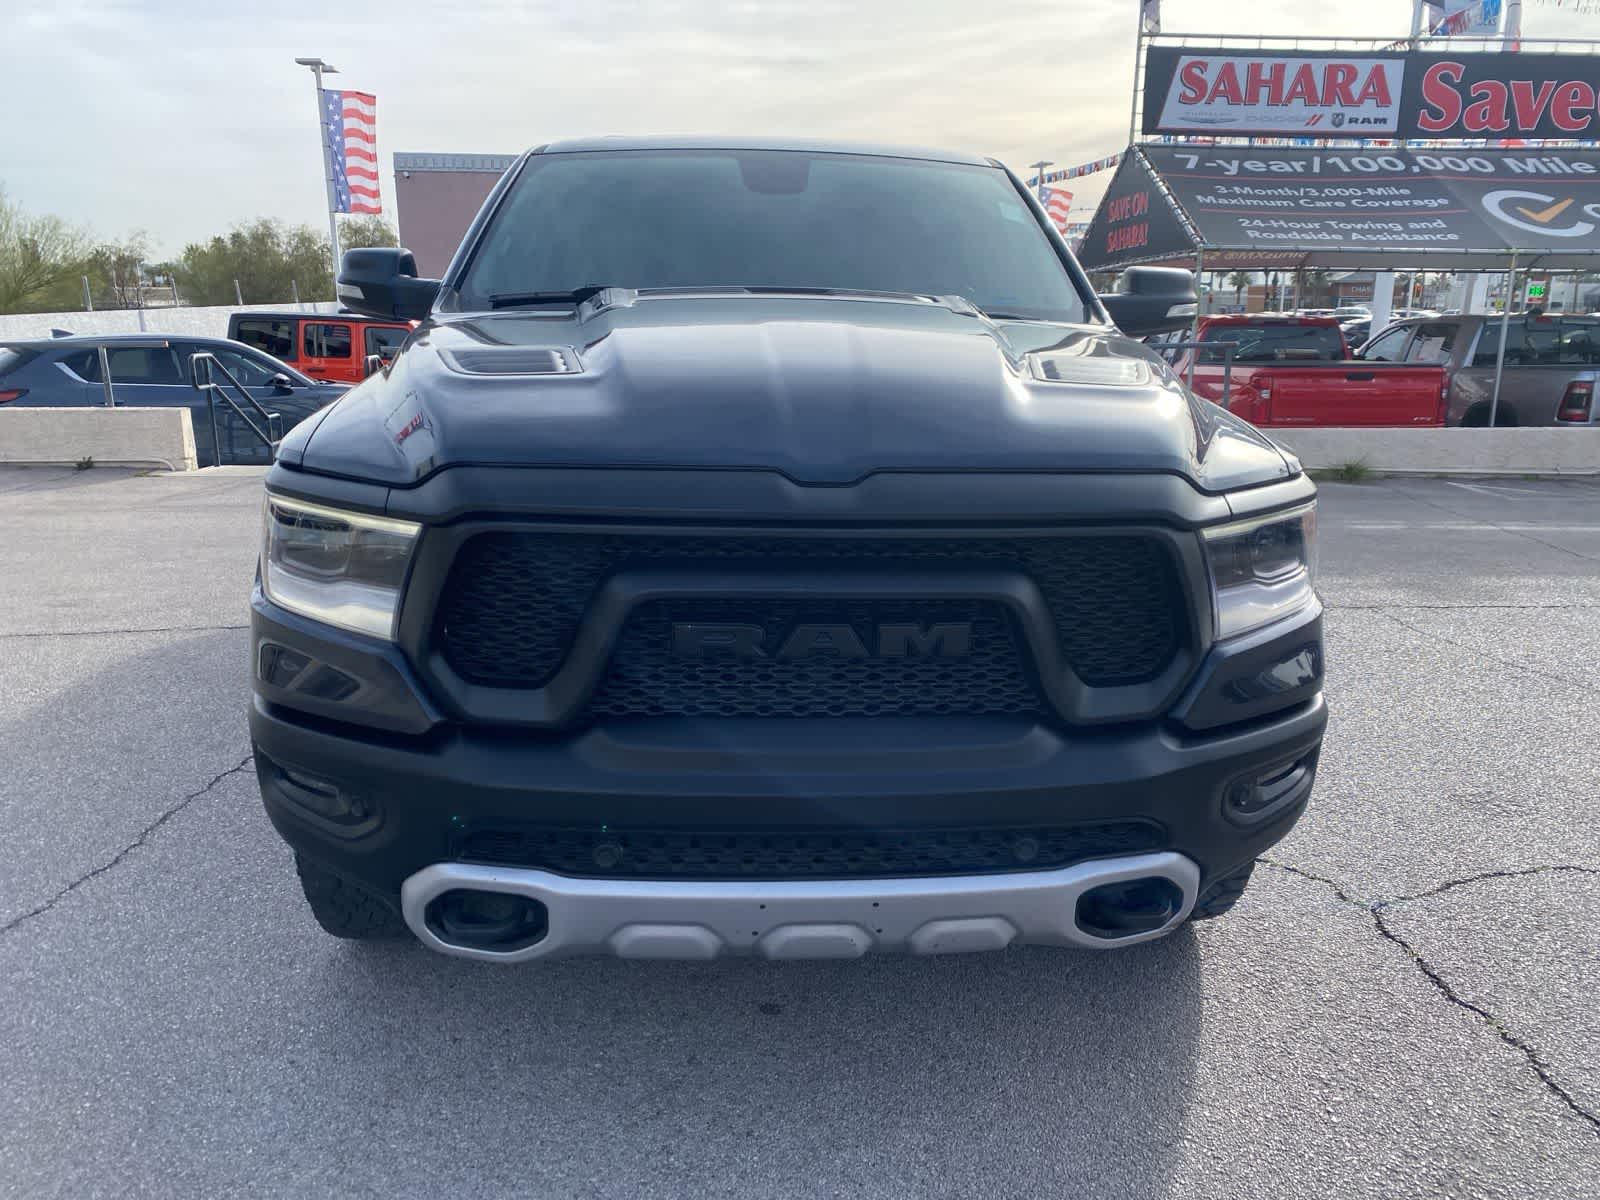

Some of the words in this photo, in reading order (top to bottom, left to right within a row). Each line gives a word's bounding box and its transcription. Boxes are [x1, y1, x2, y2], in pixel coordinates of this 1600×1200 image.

[1178, 61, 1392, 107] SAHARA
[1417, 61, 1600, 132] Save
[1501, 156, 1598, 174] Mile
[1196, 194, 1295, 208] Maximum
[1300, 198, 1346, 208] Care
[1351, 197, 1449, 209] Coverage
[1238, 218, 1320, 229] 24-Hour
[1324, 220, 1403, 231] Towing
[1408, 219, 1447, 229] and
[1245, 229, 1344, 241] Roadside
[1351, 232, 1460, 241] Assistance
[671, 622, 972, 658] RAM
